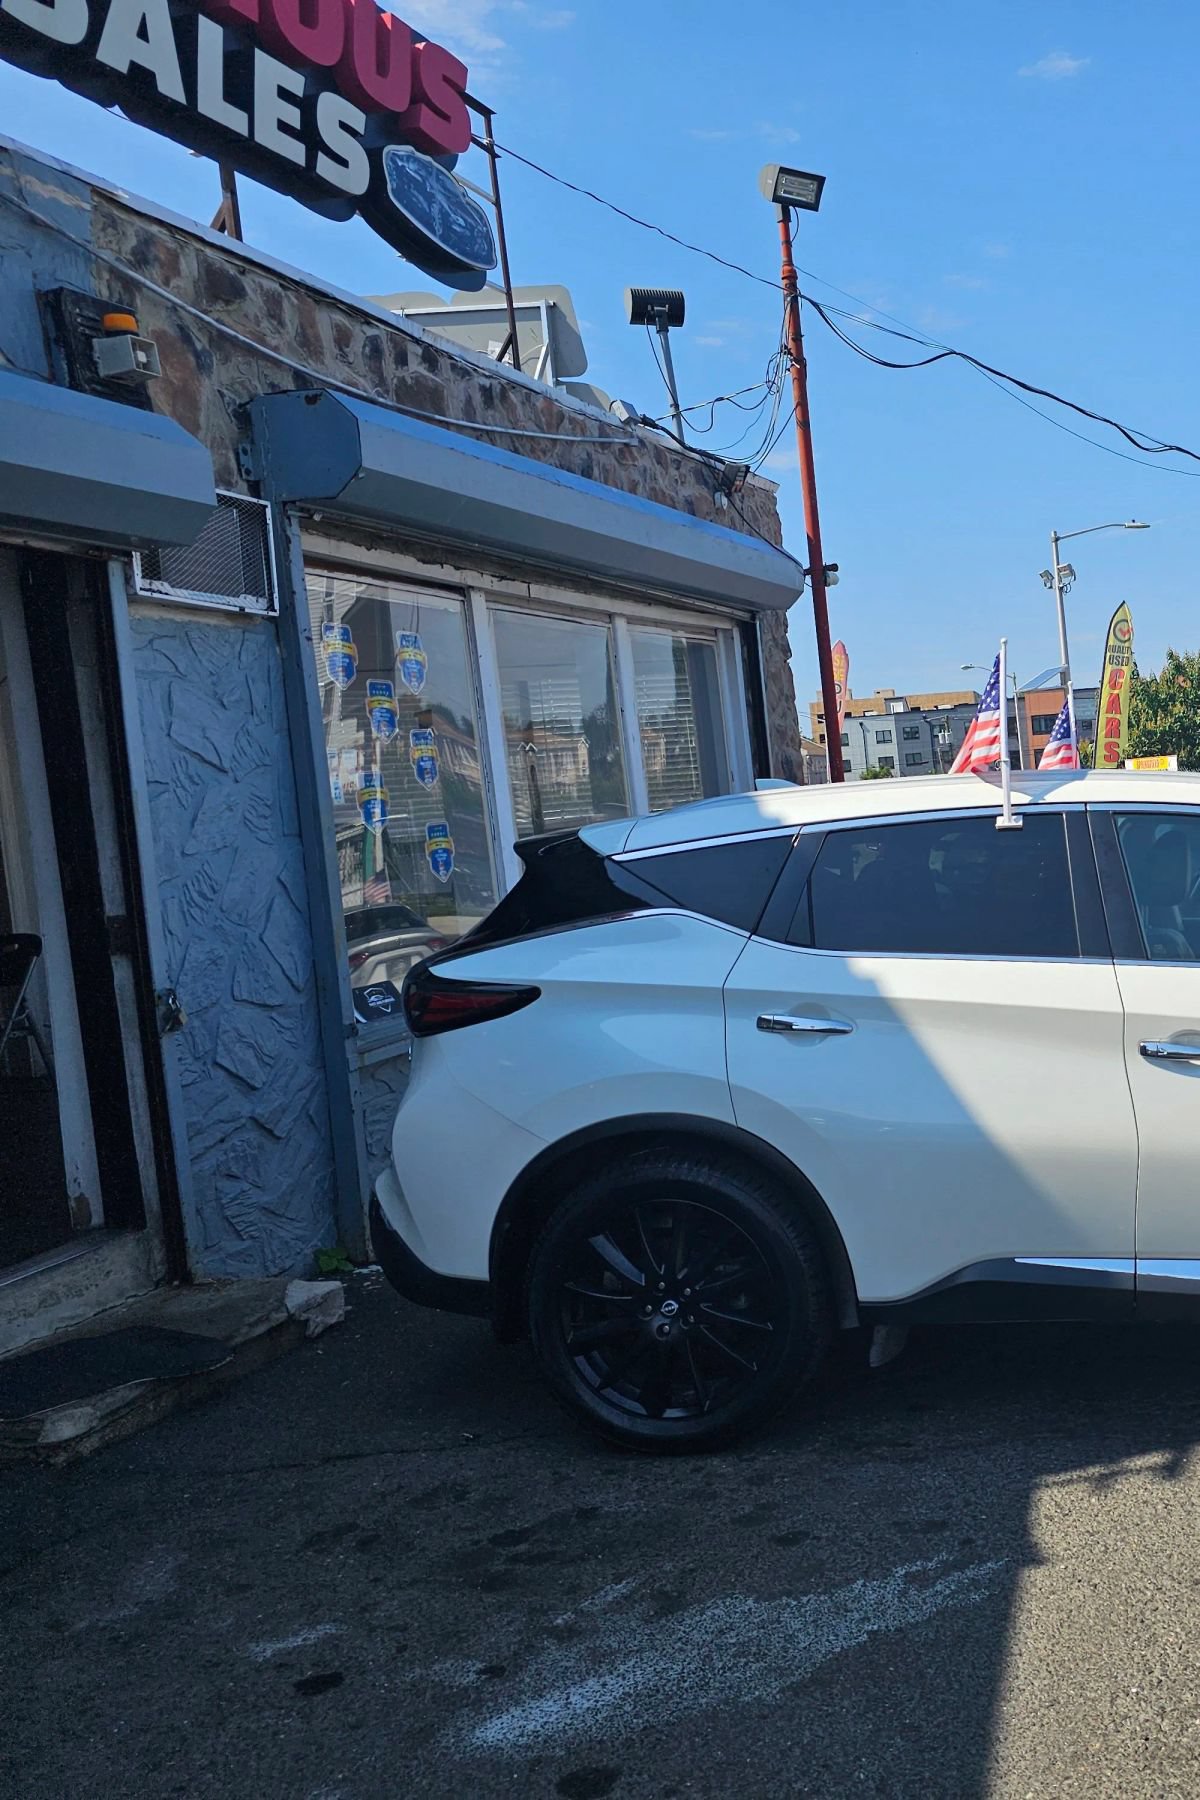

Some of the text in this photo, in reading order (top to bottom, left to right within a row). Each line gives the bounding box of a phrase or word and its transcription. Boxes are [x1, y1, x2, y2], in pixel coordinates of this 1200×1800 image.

[229, 0, 472, 154] OUS
[1108, 654, 1130, 667] USED
[1103, 668, 1126, 763] CARS
